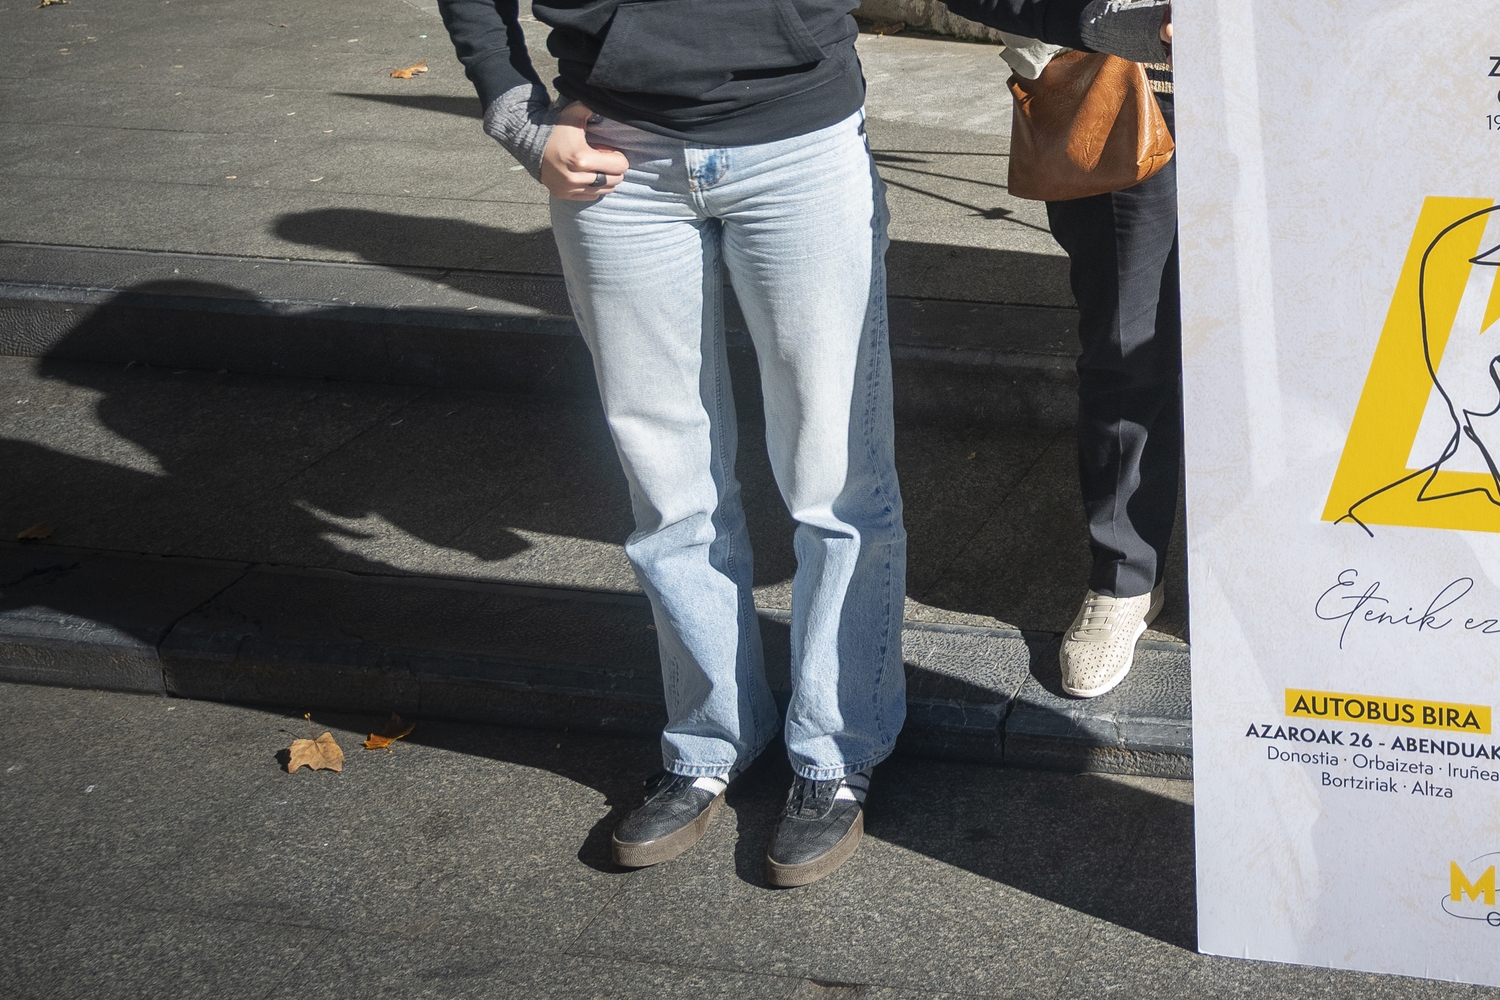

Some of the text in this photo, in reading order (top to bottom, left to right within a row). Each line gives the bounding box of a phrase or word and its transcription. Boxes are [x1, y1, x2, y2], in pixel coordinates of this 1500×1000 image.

[1314, 568, 1474, 650] Etenik
[1292, 694, 1482, 730] AUTOBUS BIRA
[1245, 722, 1345, 746] AZAROAK
[1349, 732, 1374, 748] 26
[1267, 745, 1339, 766] Donostia
[1352, 754, 1434, 775] Orbaizeta
[1448, 762, 1500, 782] Iruñea
[1321, 771, 1398, 793] Bortziriak
[1411, 780, 1454, 799] Altza
